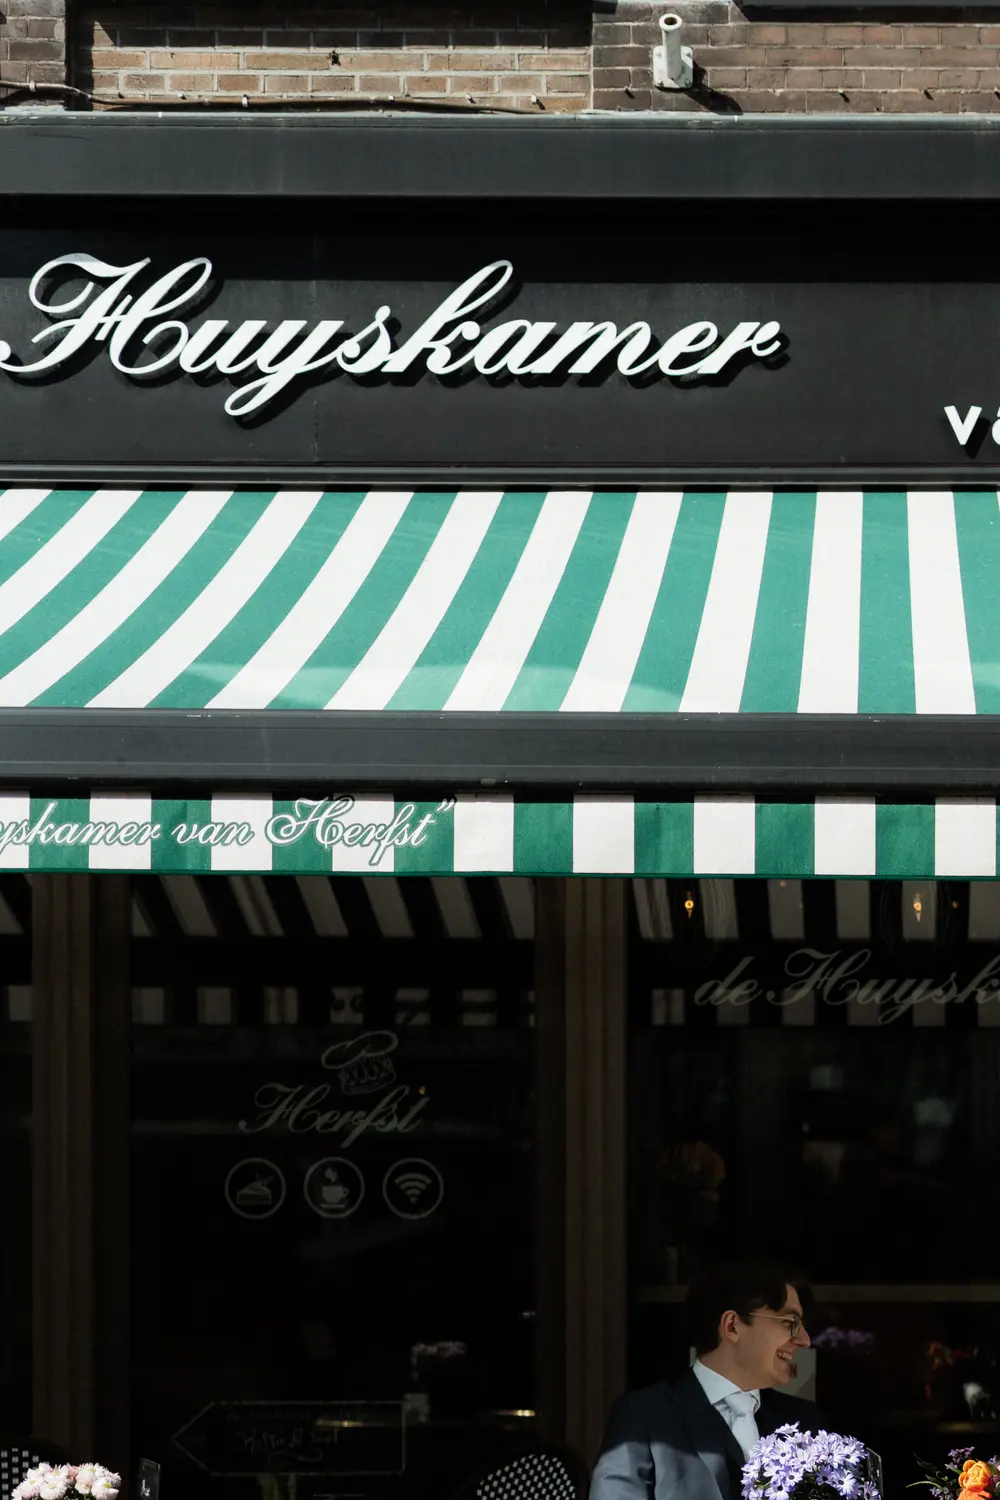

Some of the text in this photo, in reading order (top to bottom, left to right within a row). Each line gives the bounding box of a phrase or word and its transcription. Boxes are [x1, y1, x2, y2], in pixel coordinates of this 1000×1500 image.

[0, 252, 782, 416] Huyskamer
[171, 819, 255, 846] van
[693, 955, 764, 1007] de
[238, 1081, 432, 1148] Herfst
